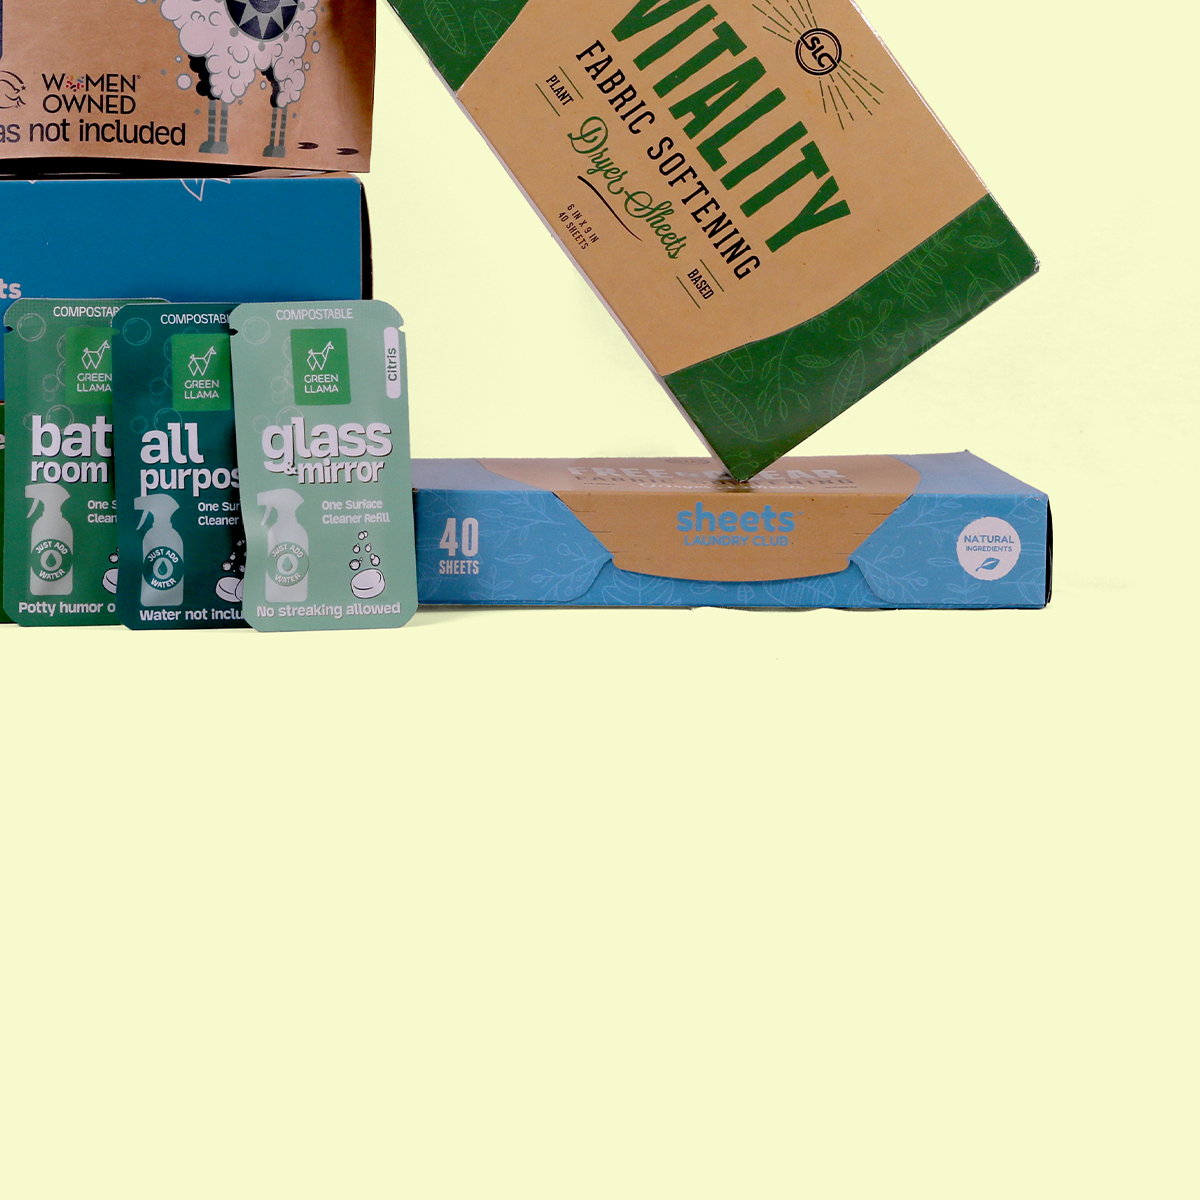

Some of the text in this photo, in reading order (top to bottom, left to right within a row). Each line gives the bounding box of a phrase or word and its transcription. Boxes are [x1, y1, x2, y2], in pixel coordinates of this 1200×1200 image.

[546, 74, 574, 107] PLANT
[42, 94, 136, 114] OWNED
[29, 118, 70, 142] not
[79, 118, 186, 146] included
[576, 40, 760, 280] FABRIC SOFTENING
[567, 116, 689, 259] Dryer Sheets
[566, 222, 589, 250] SHEETS
[687, 268, 714, 300] BASED
[276, 308, 353, 320] COMPOSTABLE
[387, 347, 397, 382] Citris
[77, 373, 112, 382] GREEN
[304, 374, 339, 383] GREEN
[77, 383, 112, 392] LLAMA
[184, 379, 220, 389] GREEN
[304, 384, 339, 394] LLAMA
[184, 390, 220, 400] LLAMA
[31, 415, 113, 458] bat
[140, 422, 204, 464] all
[261, 416, 393, 474] glass
[31, 460, 108, 483] room
[566, 467, 674, 478] FREE
[87, 500, 109, 510] One
[197, 502, 219, 512] One
[322, 499, 383, 510] One Surface
[197, 516, 239, 526] Cleaner
[322, 513, 390, 524] Cleaner Refill
[676, 502, 795, 532] sheets
[440, 517, 479, 557] 40
[684, 535, 788, 546] LAUNDRY CLUB
[964, 535, 1014, 543] NATURAL
[439, 560, 479, 574] SHEETS
[39, 568, 66, 580] WATER
[275, 573, 301, 584] WATER
[150, 578, 177, 589] WATER
[18, 602, 56, 617] Potty
[59, 601, 103, 614] humor
[139, 609, 182, 621] Water
[185, 609, 208, 620] not
[257, 602, 401, 619] No streaking allowed
